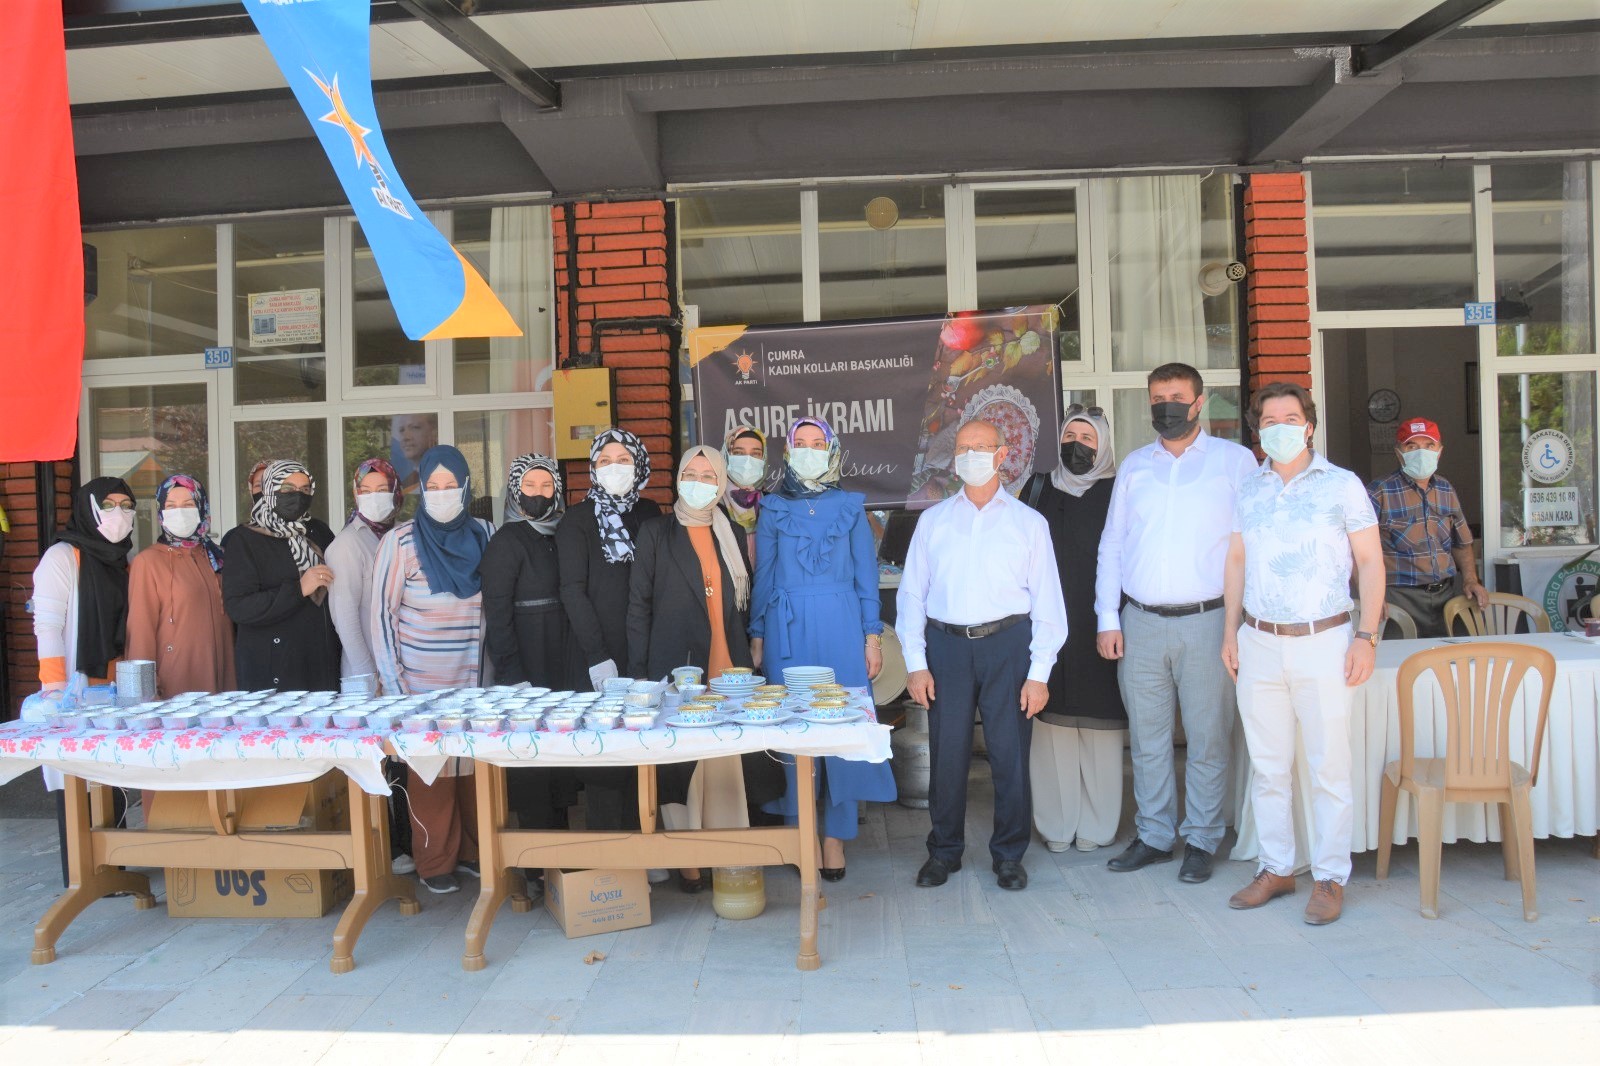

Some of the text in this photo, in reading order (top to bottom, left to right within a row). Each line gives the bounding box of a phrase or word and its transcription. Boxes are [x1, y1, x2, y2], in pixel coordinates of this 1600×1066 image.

[767, 350, 805, 362] ÇUMRA
[768, 354, 914, 376] KADIN KOLLARI BAŞKANLIĞI
[1531, 510, 1573, 522] HASAN KARA
[590, 889, 623, 903] beysu
